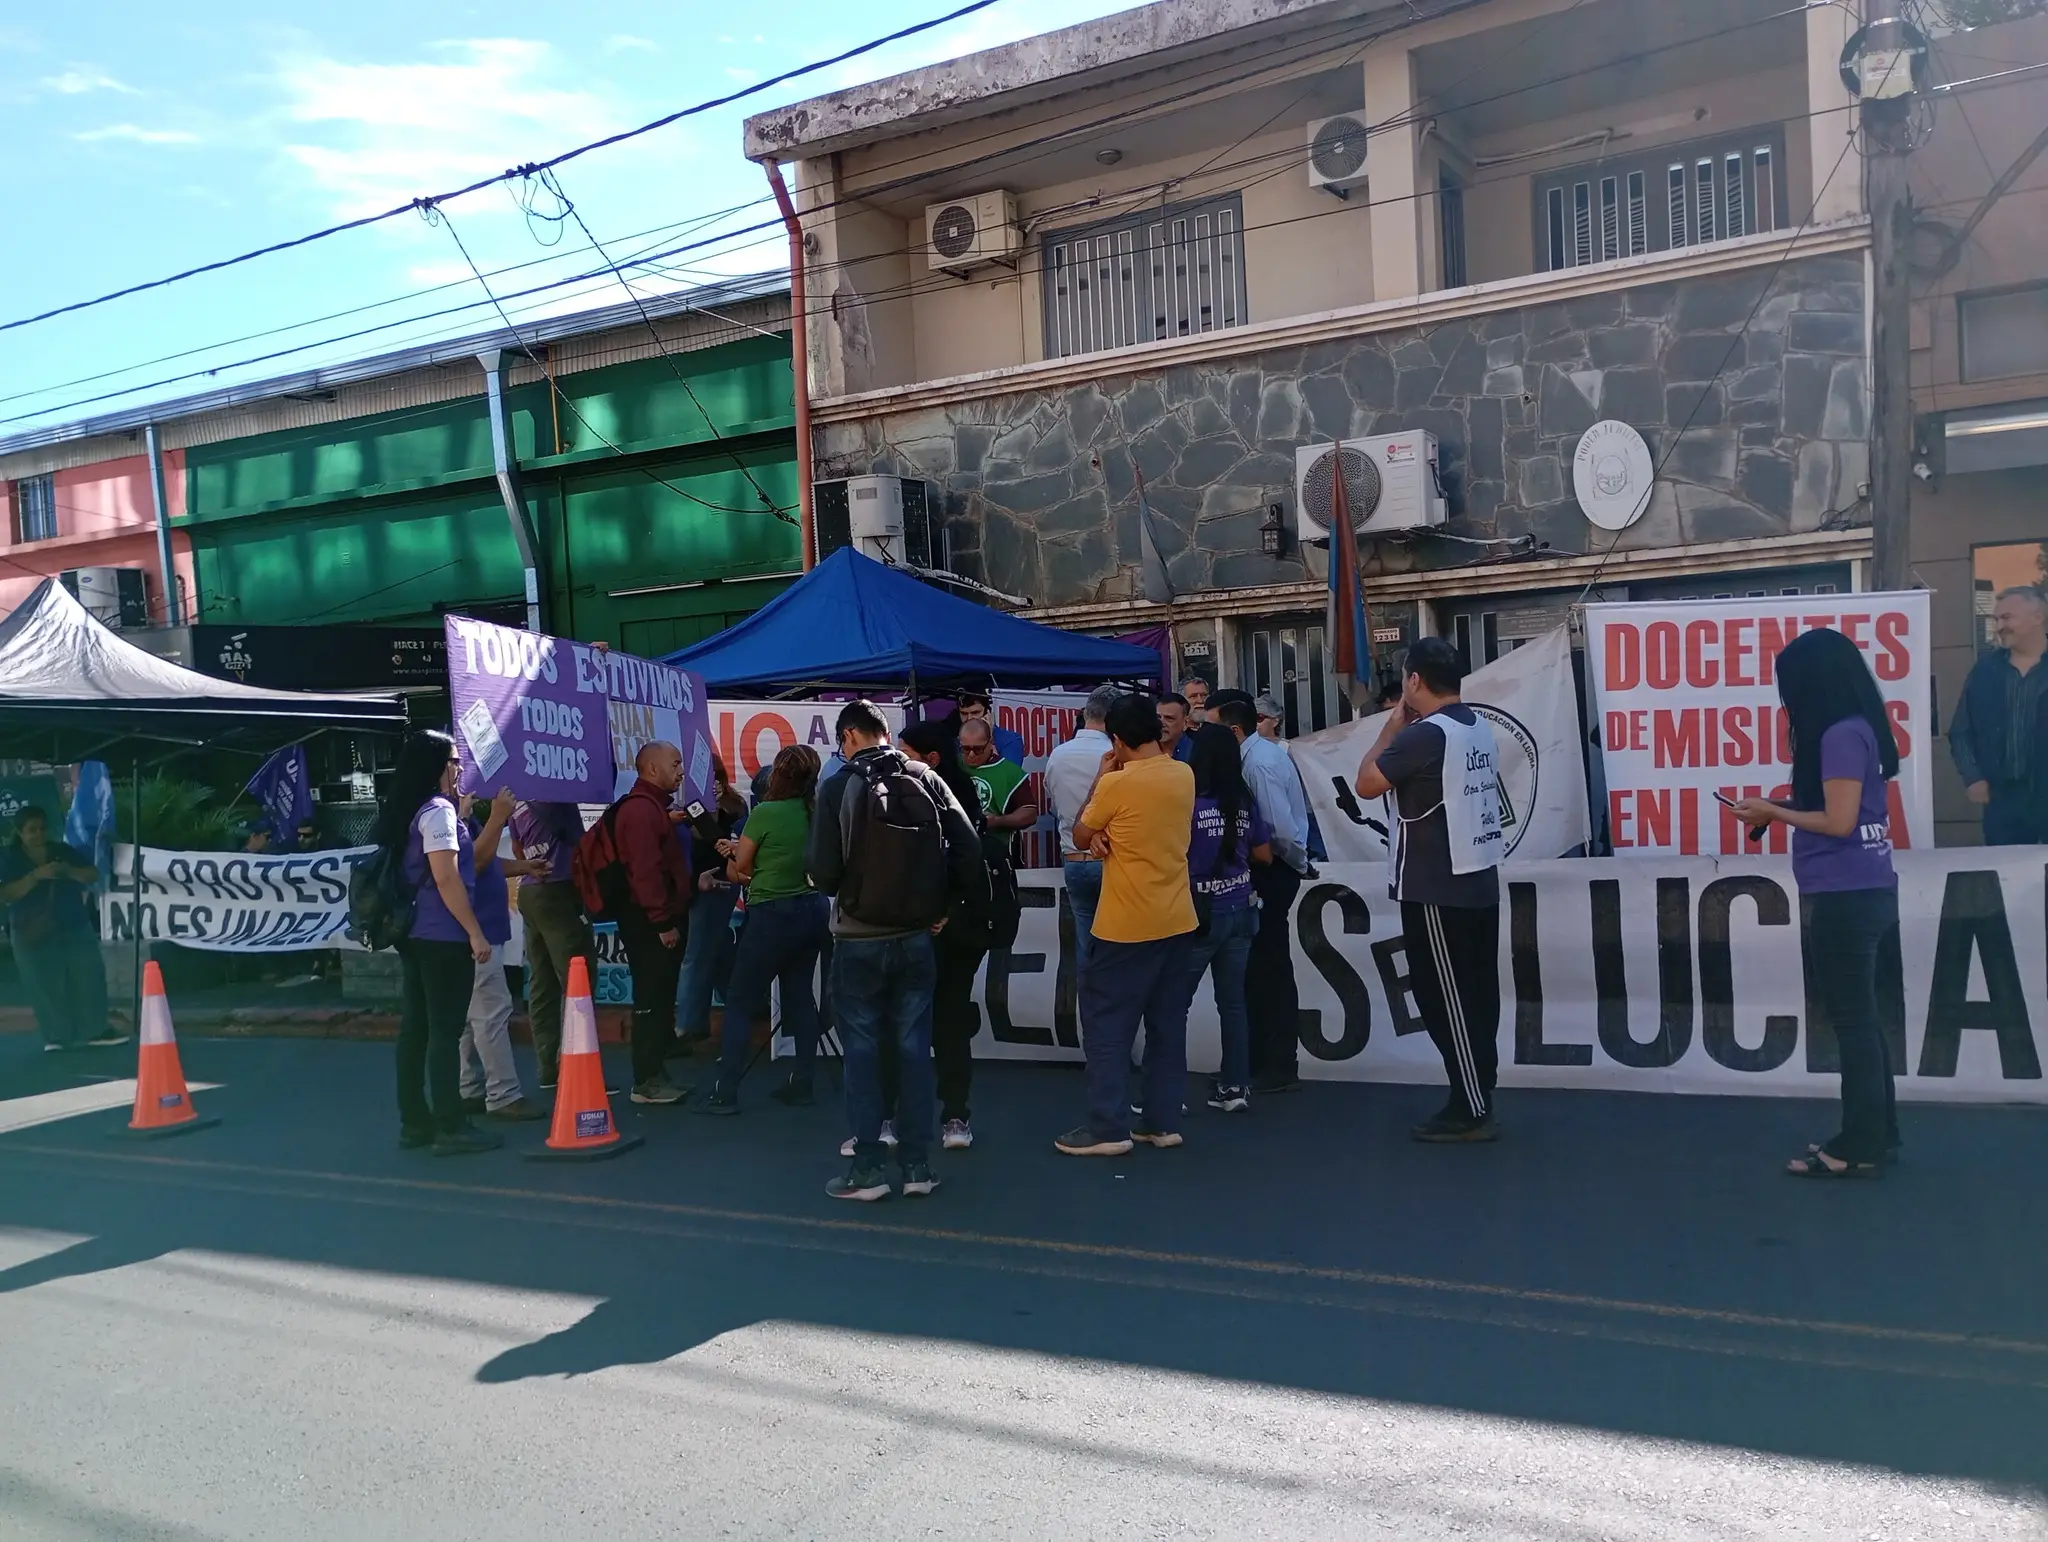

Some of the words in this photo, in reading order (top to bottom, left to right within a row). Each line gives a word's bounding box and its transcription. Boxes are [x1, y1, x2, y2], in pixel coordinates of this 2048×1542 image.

[457, 620, 558, 684] TODOS
[572, 645, 694, 713] ESTUVIMOS
[1604, 612, 1910, 692] DOCENES
[517, 696, 584, 741] TODOS
[609, 701, 656, 739] JUAN
[808, 714, 830, 745] A
[1606, 710, 1649, 751] DE
[1654, 700, 1912, 769] MISIS
[524, 740, 590, 782] SOMOS
[1521, 740, 1536, 770] LUCHA
[1198, 818, 1220, 829] NUEVA
[1208, 828, 1217, 837] DE
[1609, 786, 1672, 848] EN
[167, 853, 376, 905] PROTEST
[110, 900, 160, 941] NO
[168, 903, 212, 942] ES
